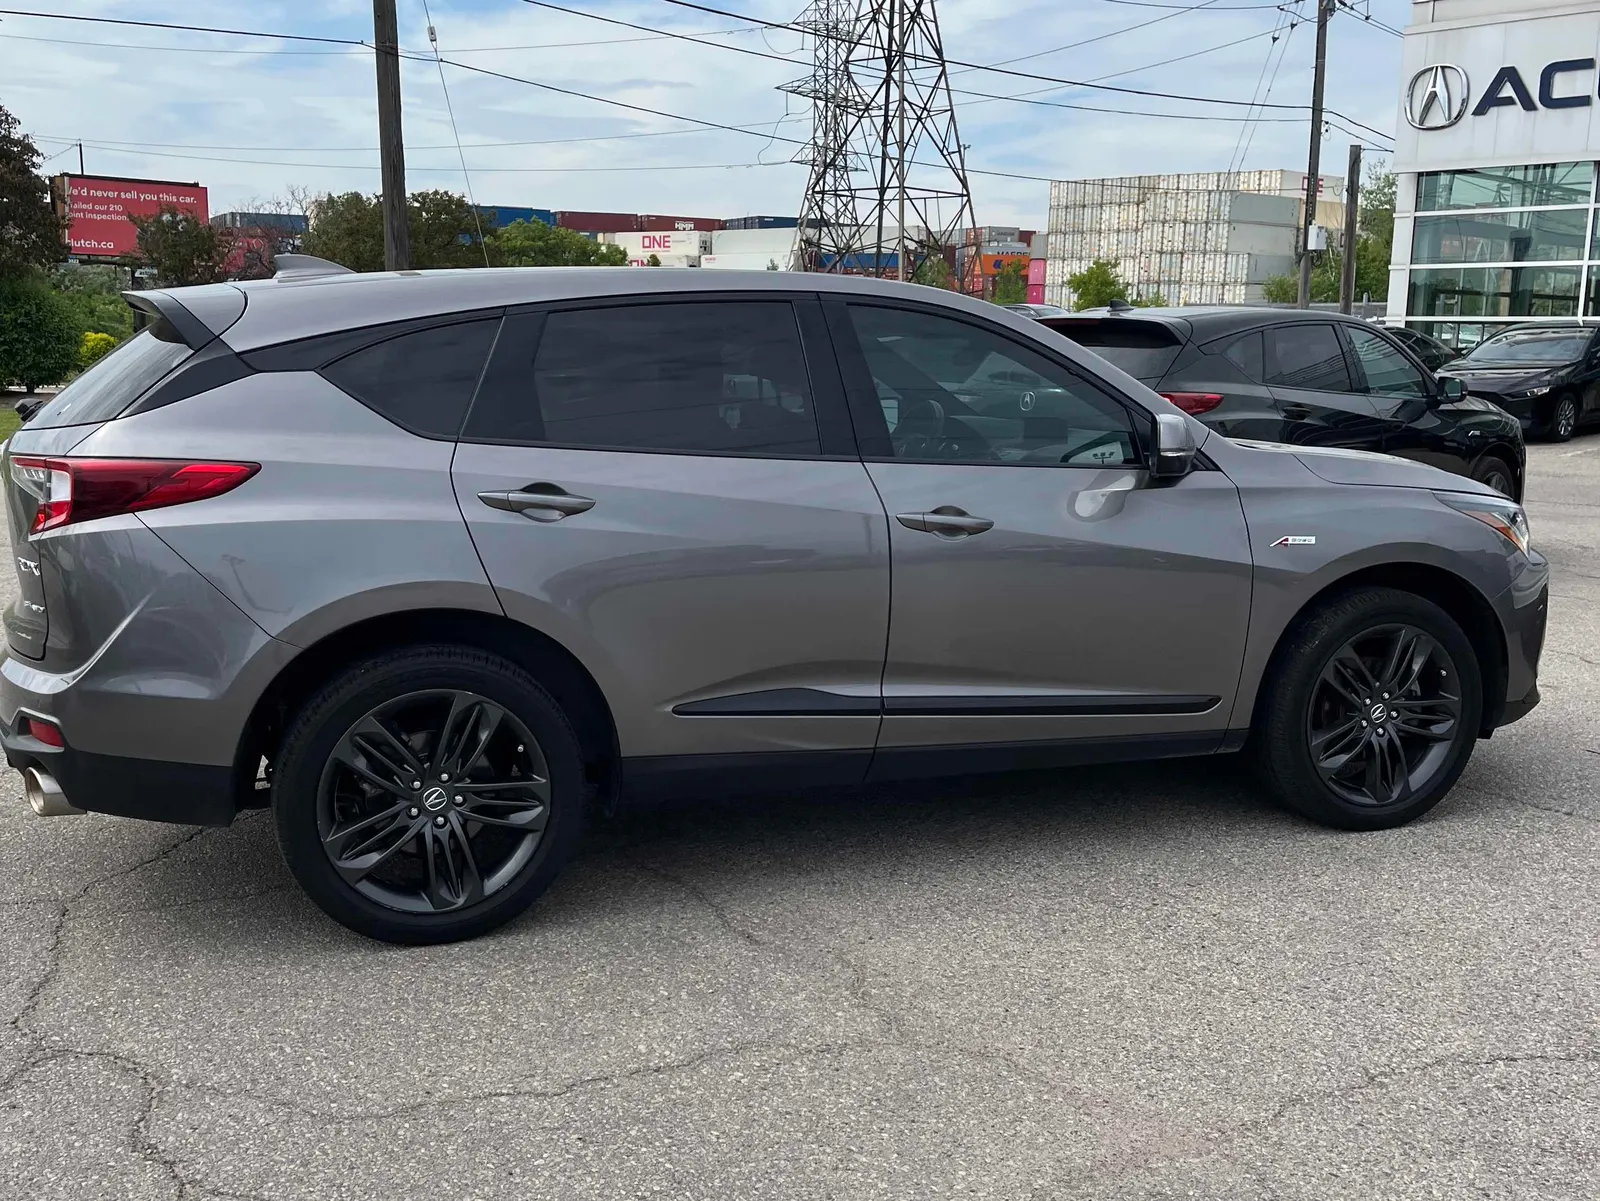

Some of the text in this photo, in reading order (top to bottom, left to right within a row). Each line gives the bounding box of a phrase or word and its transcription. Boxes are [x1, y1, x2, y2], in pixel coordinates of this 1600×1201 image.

[1471, 58, 1600, 116] AC
[68, 186, 197, 204] e'd never sell you this car.
[109, 204, 123, 212] 210
[85, 211, 129, 221] inspection.
[642, 234, 671, 249] ONE
